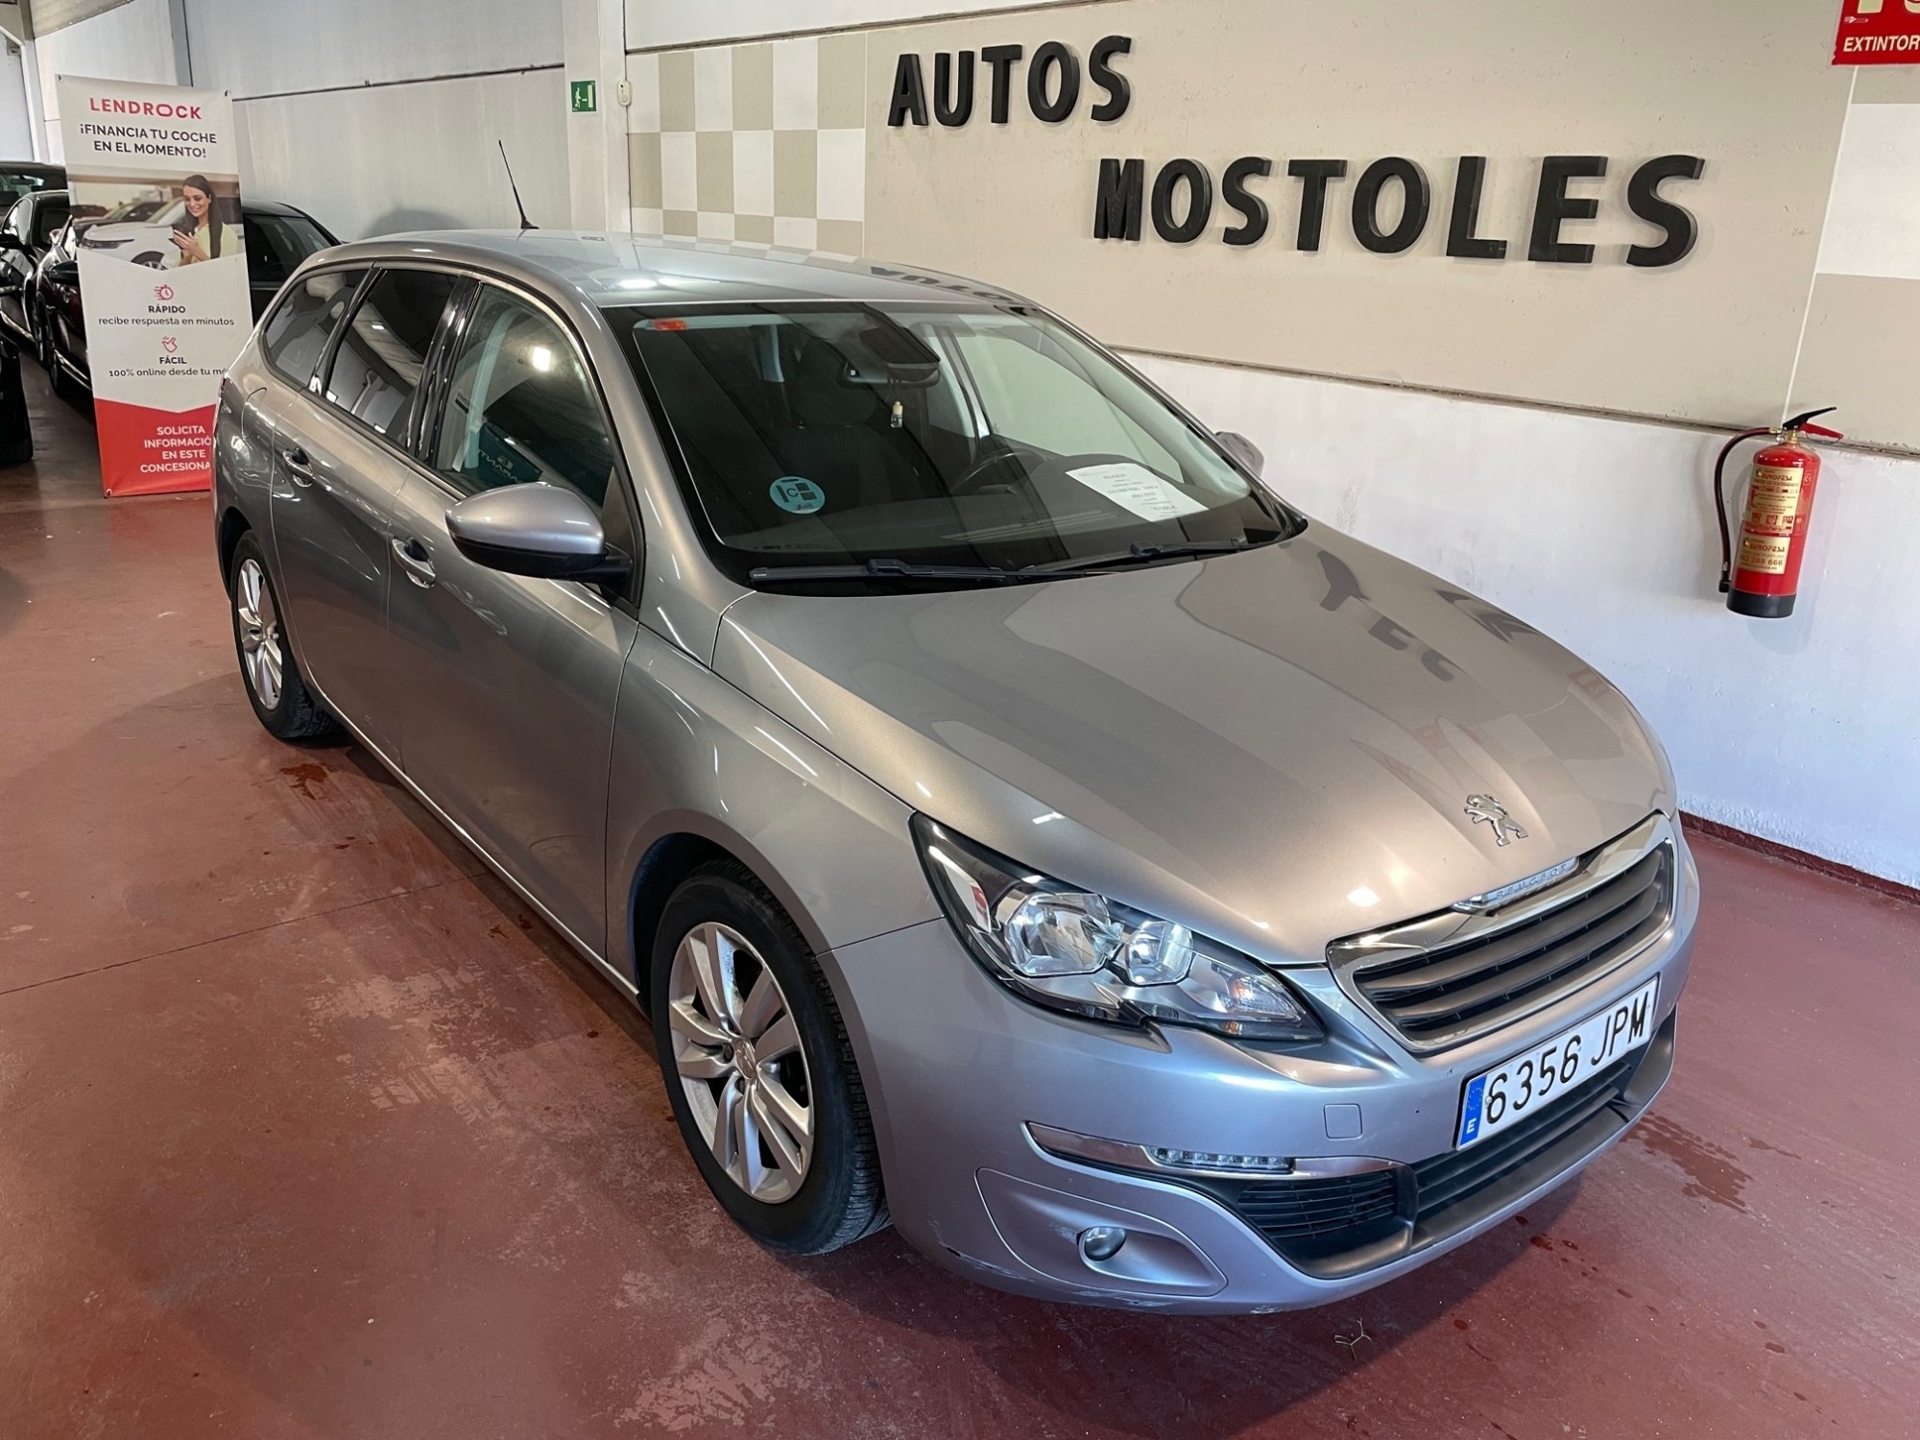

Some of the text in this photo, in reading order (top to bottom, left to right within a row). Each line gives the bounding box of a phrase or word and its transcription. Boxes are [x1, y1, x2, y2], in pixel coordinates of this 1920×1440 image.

[1843, 34, 1920, 52] EXTINTOR
[887, 35, 1132, 127] AUTOS
[90, 98, 202, 120] LENDROCK
[80, 123, 217, 143] ¡FINANCIA TU COCHE
[94, 140, 206, 158] EN EL MOMENTO!
[1093, 154, 1706, 268] MOSTOLES
[148, 304, 186, 313] RÁPIDO
[98, 317, 129, 325] recibe
[132, 318, 180, 327] respuesta
[196, 318, 234, 326] minutos
[159, 354, 187, 364] FÁCIL
[109, 369, 134, 377] 100%
[137, 368, 167, 376] online
[168, 368, 198, 376] desde
[157, 425, 206, 436] SOLICITA
[144, 435, 212, 448] INFORMACIÓ
[162, 449, 206, 460] EN ESTE
[140, 461, 211, 473] CONCESIONA
[1466, 991, 1649, 1135] E 6356 JPM
